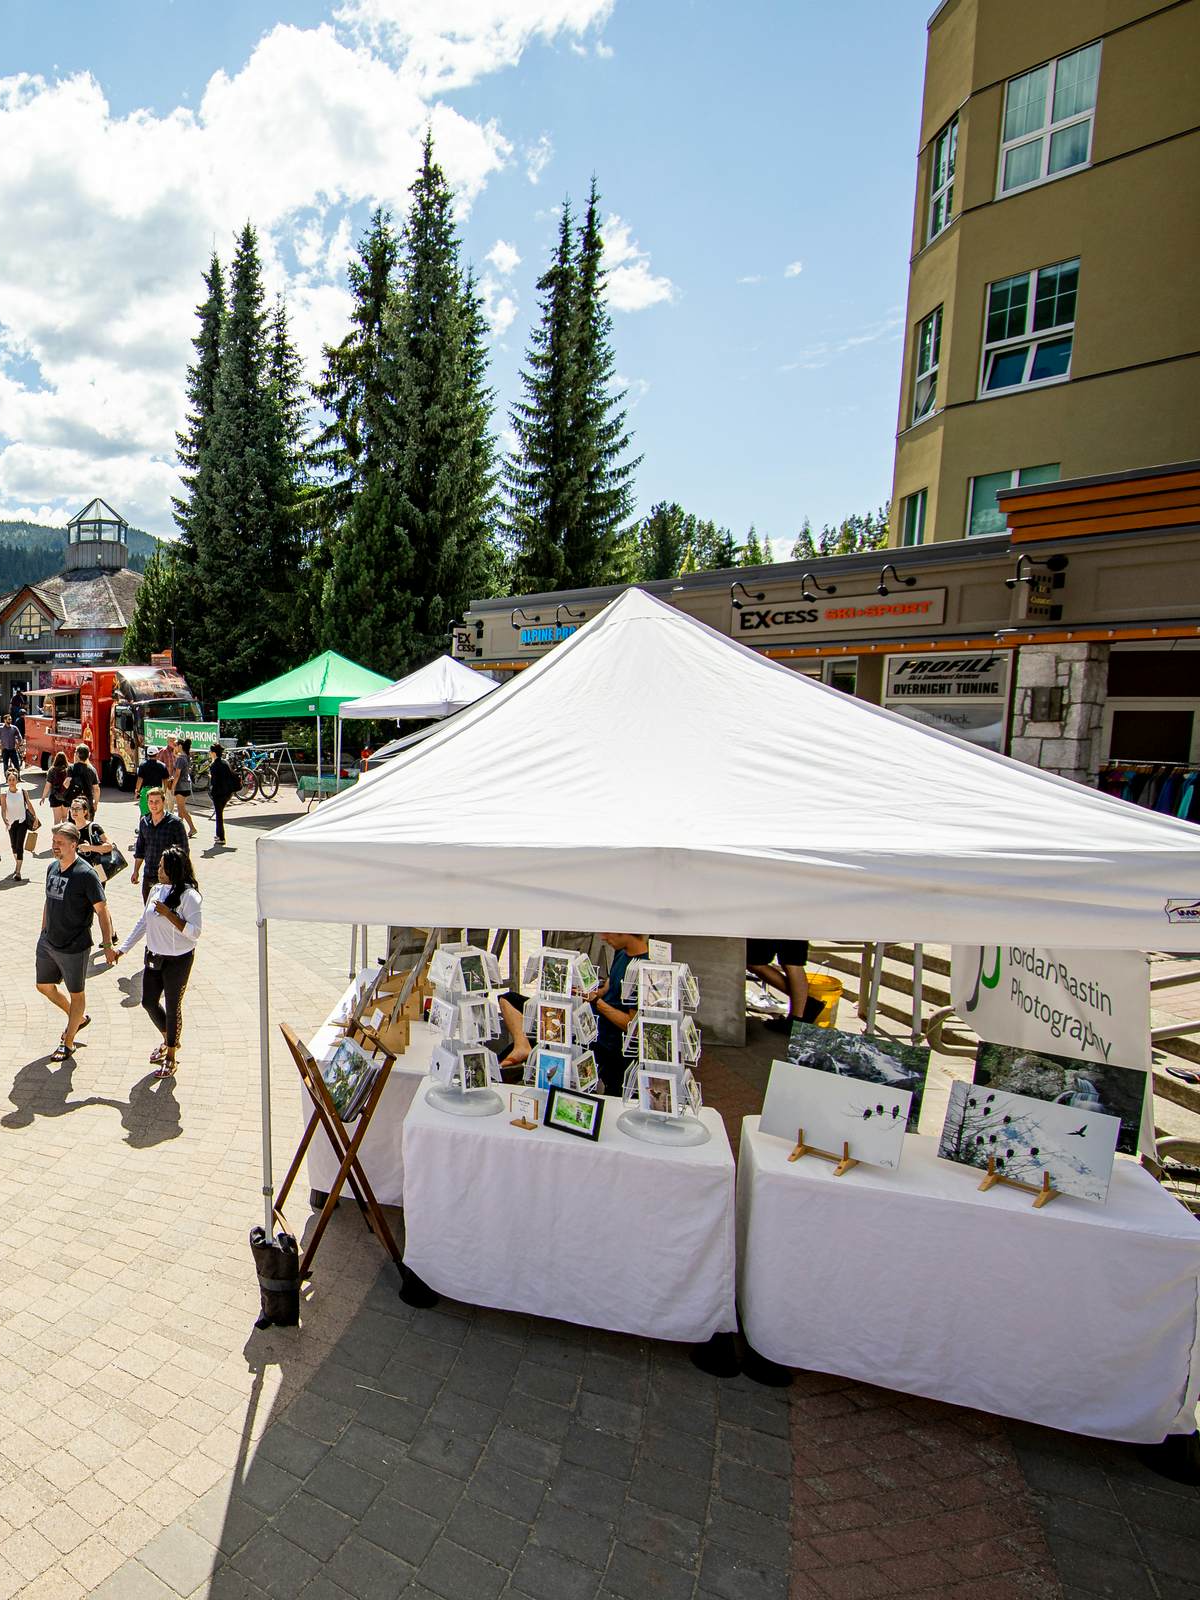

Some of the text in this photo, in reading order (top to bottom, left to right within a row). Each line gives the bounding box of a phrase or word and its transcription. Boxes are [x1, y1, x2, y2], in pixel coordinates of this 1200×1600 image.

[739, 608, 819, 630] EXCESS
[457, 632, 471, 644] EX
[521, 627, 554, 643] ALPINE
[456, 645, 476, 653] CESS
[895, 657, 1001, 675] PROFILE
[893, 681, 999, 695] OVERNIGHT TUNING
[185, 730, 217, 742] PARKING
[1010, 977, 1112, 1063] Photography
